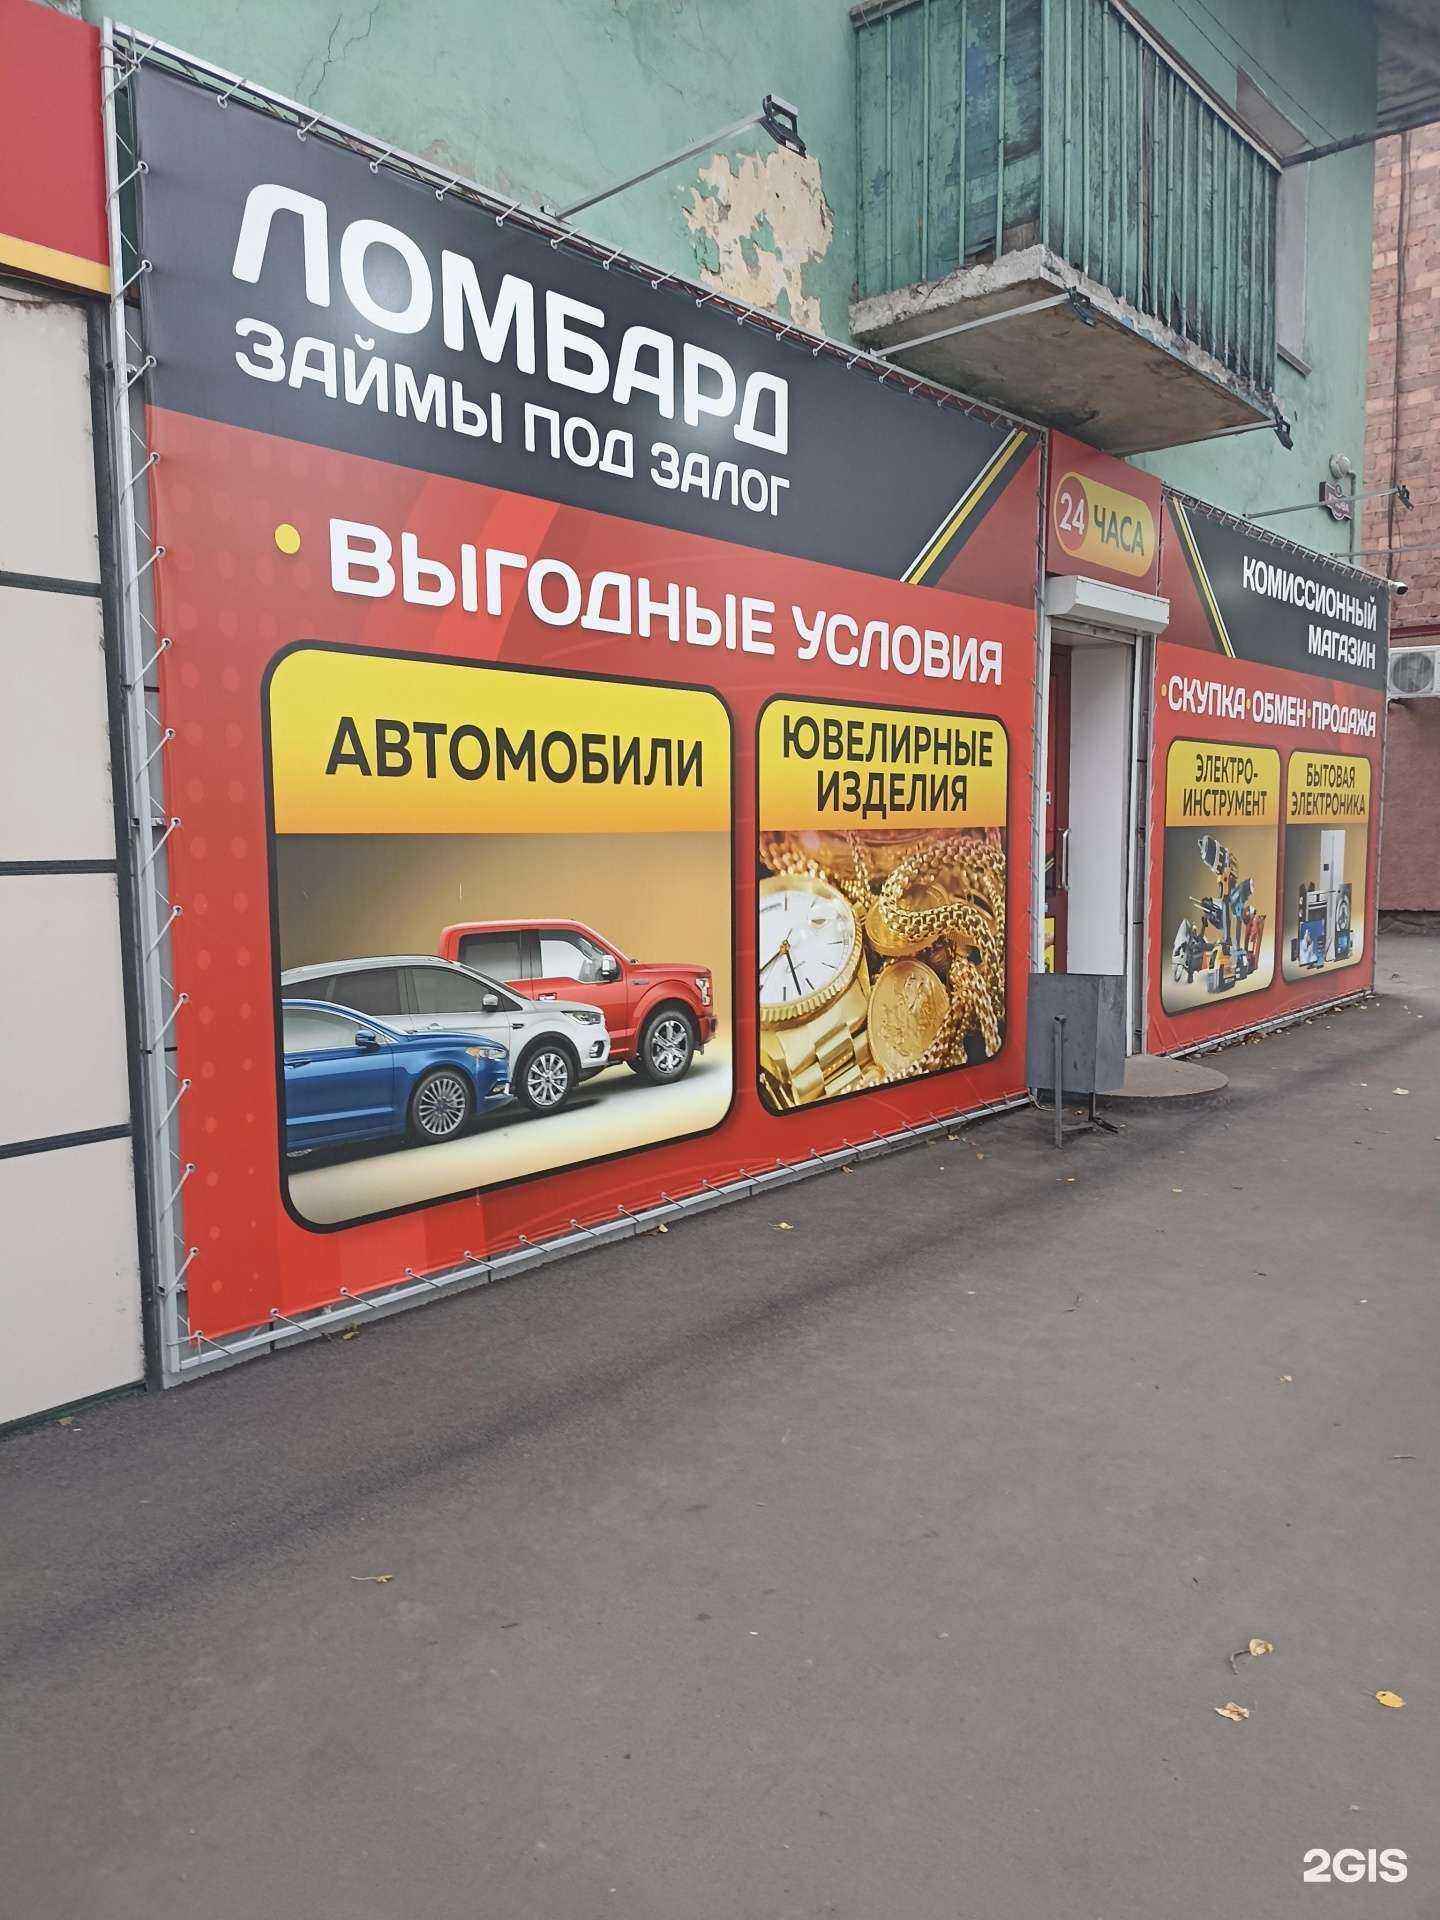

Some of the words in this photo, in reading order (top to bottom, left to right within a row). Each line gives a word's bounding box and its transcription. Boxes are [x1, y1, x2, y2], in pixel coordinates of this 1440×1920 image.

[232, 183, 789, 455] ЛОМБАРД
[235, 317, 502, 443] ЗАЙМЫ
[524, 402, 634, 479] ПОД
[650, 442, 790, 516] ЗАЛОГ
[1059, 492, 1085, 536] 24
[1093, 504, 1145, 557] ЧАСА
[329, 517, 776, 656] ВЫГОДНЫЕ
[791, 605, 1004, 686] УСЛОВИЯ
[1243, 555, 1378, 632] КОМИССИОННЫЙ
[1308, 624, 1377, 670] МАГАЗИН
[1168, 675, 1246, 720] СКУПКА
[1252, 690, 1307, 729] ОБМЕН
[1311, 701, 1377, 738] ПРОДАЖА
[325, 716, 705, 788] АВТОМОБИЛИ
[782, 714, 994, 768] ЮВЕЛИРНЫЕ
[1195, 753, 1258, 785] ЭЛЕКТРО-
[815, 770, 968, 820] ИЗДЕЛИЯ
[1182, 788, 1268, 817] ИНСТРУМЕНТ
[1290, 791, 1366, 816] ЭЛЕКТРОНИКА
[1305, 762, 1356, 788] БЫТОВАЯ
